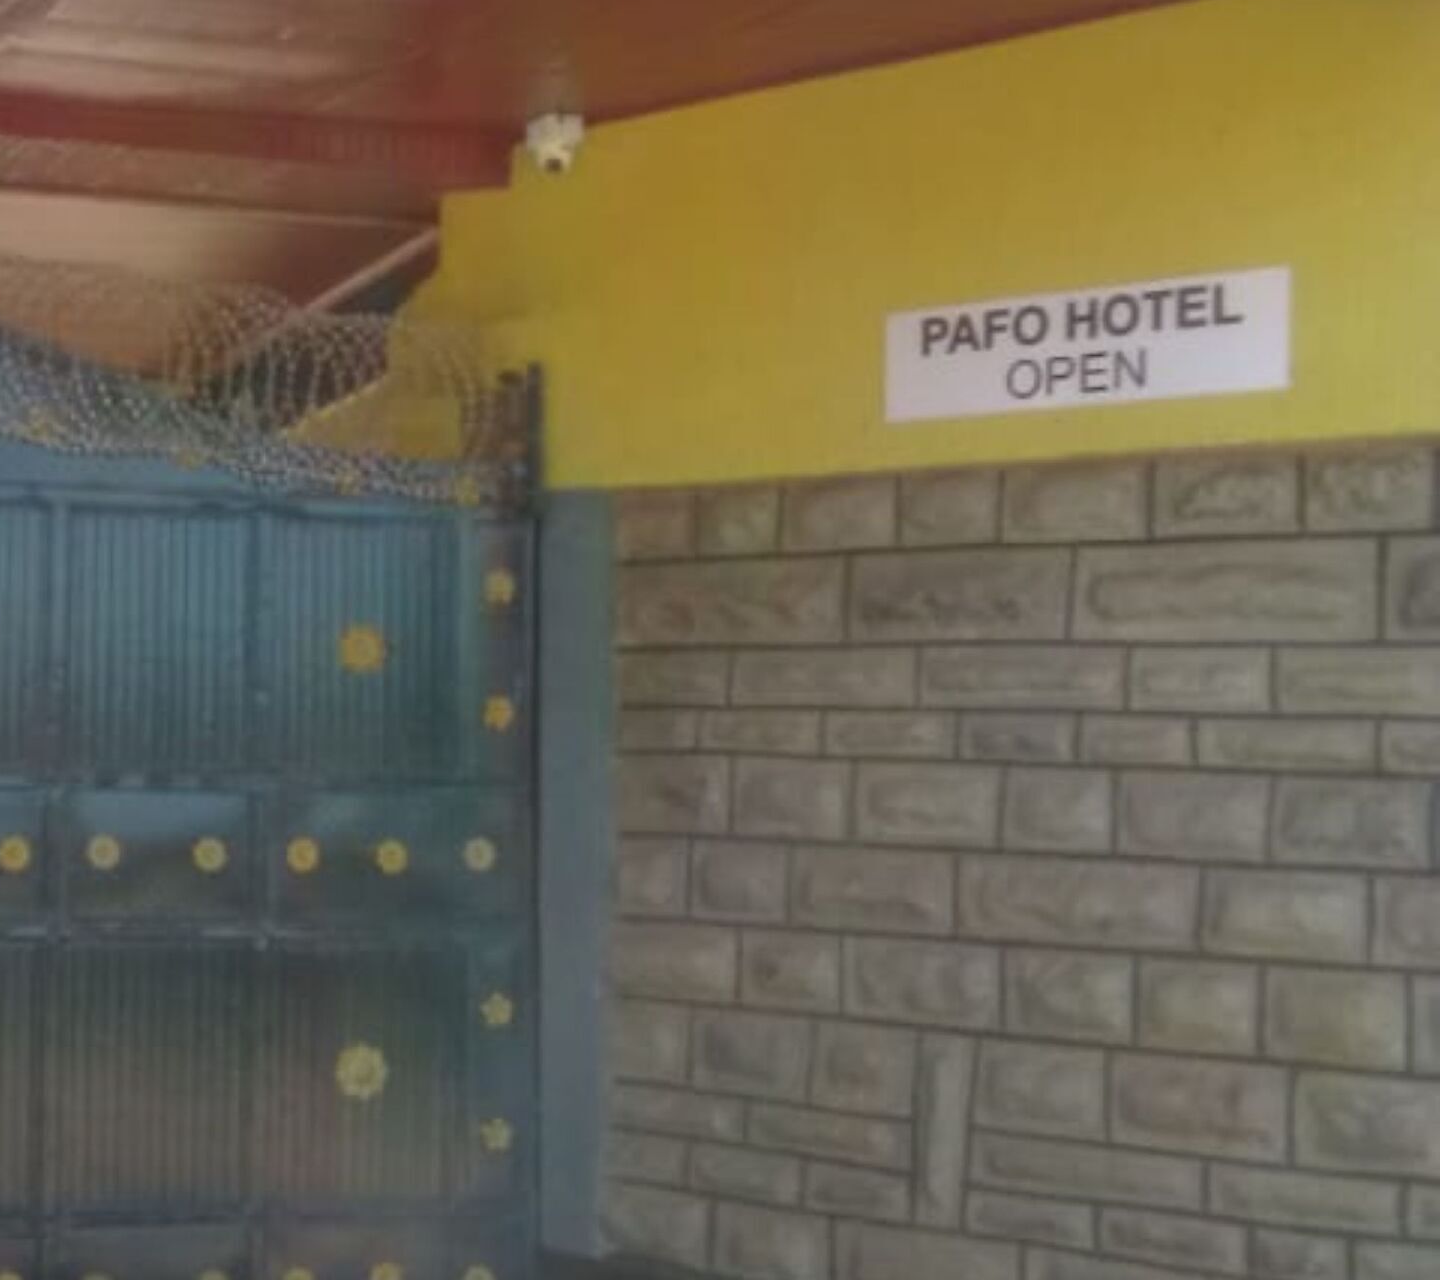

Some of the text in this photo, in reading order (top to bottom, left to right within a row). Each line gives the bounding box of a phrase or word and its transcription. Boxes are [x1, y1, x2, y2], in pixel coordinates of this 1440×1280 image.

[920, 283, 1244, 357] PAFO HOTEL
[1006, 349, 1147, 400] OPEN
